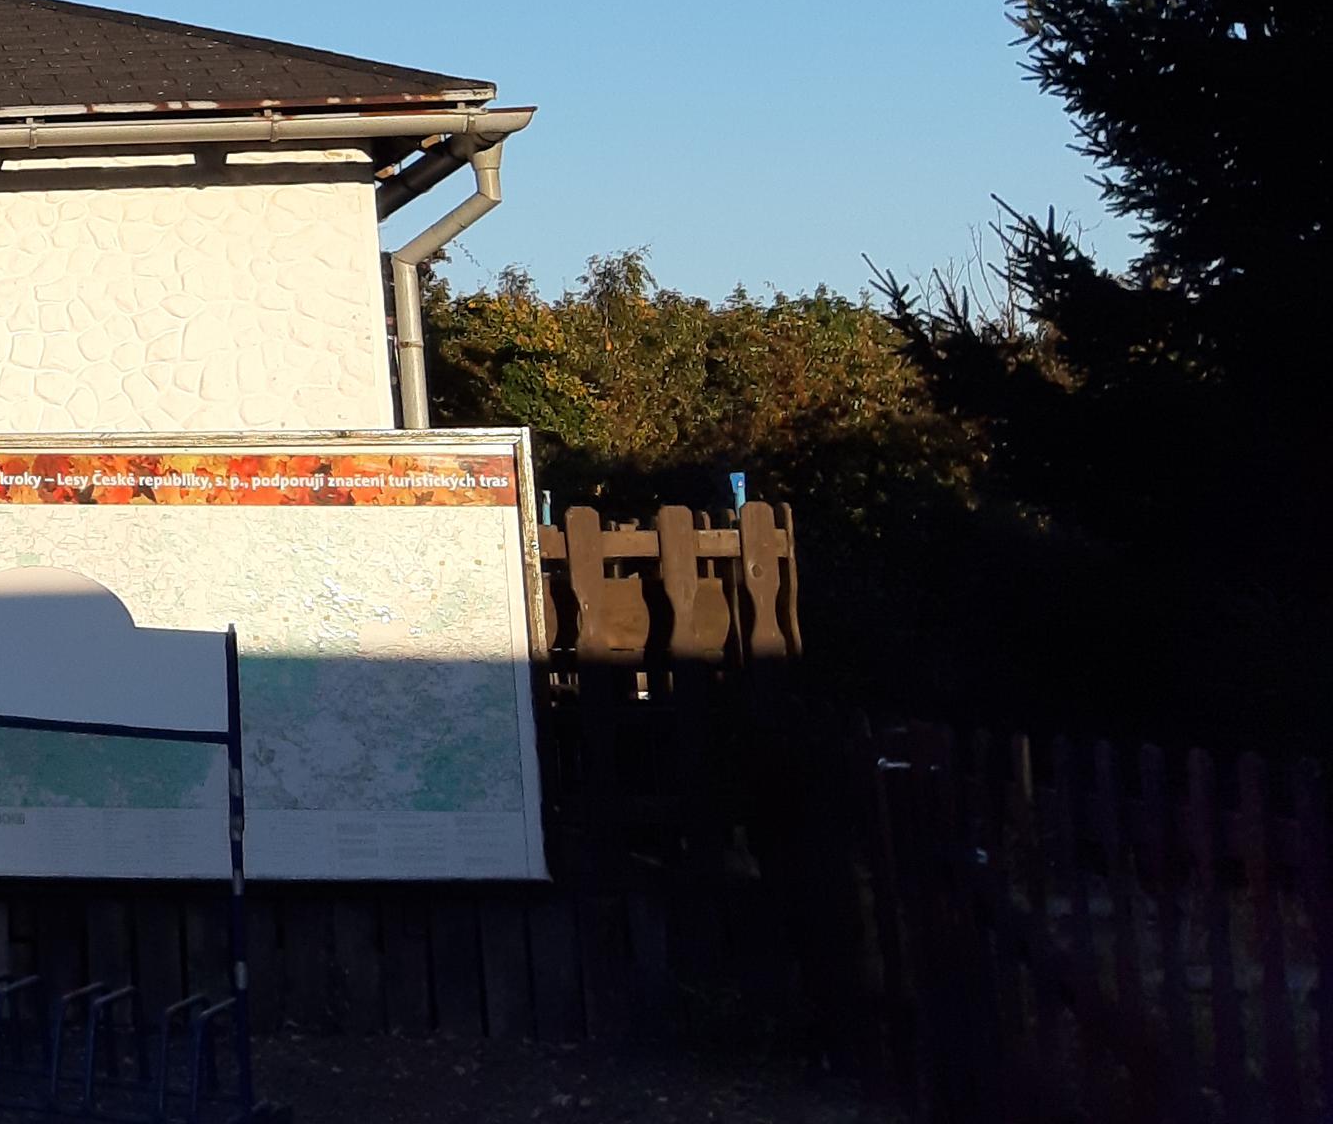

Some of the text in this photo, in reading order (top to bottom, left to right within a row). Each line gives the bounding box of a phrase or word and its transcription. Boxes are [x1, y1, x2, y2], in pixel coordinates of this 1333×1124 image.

[0, 472, 41, 490] kroky
[57, 473, 89, 491] Lesy
[92, 469, 135, 487] České
[138, 473, 213, 492] republiky,
[251, 473, 324, 491] podporují
[327, 473, 384, 488] značení
[388, 472, 476, 491] turistických
[479, 474, 508, 488] tras
